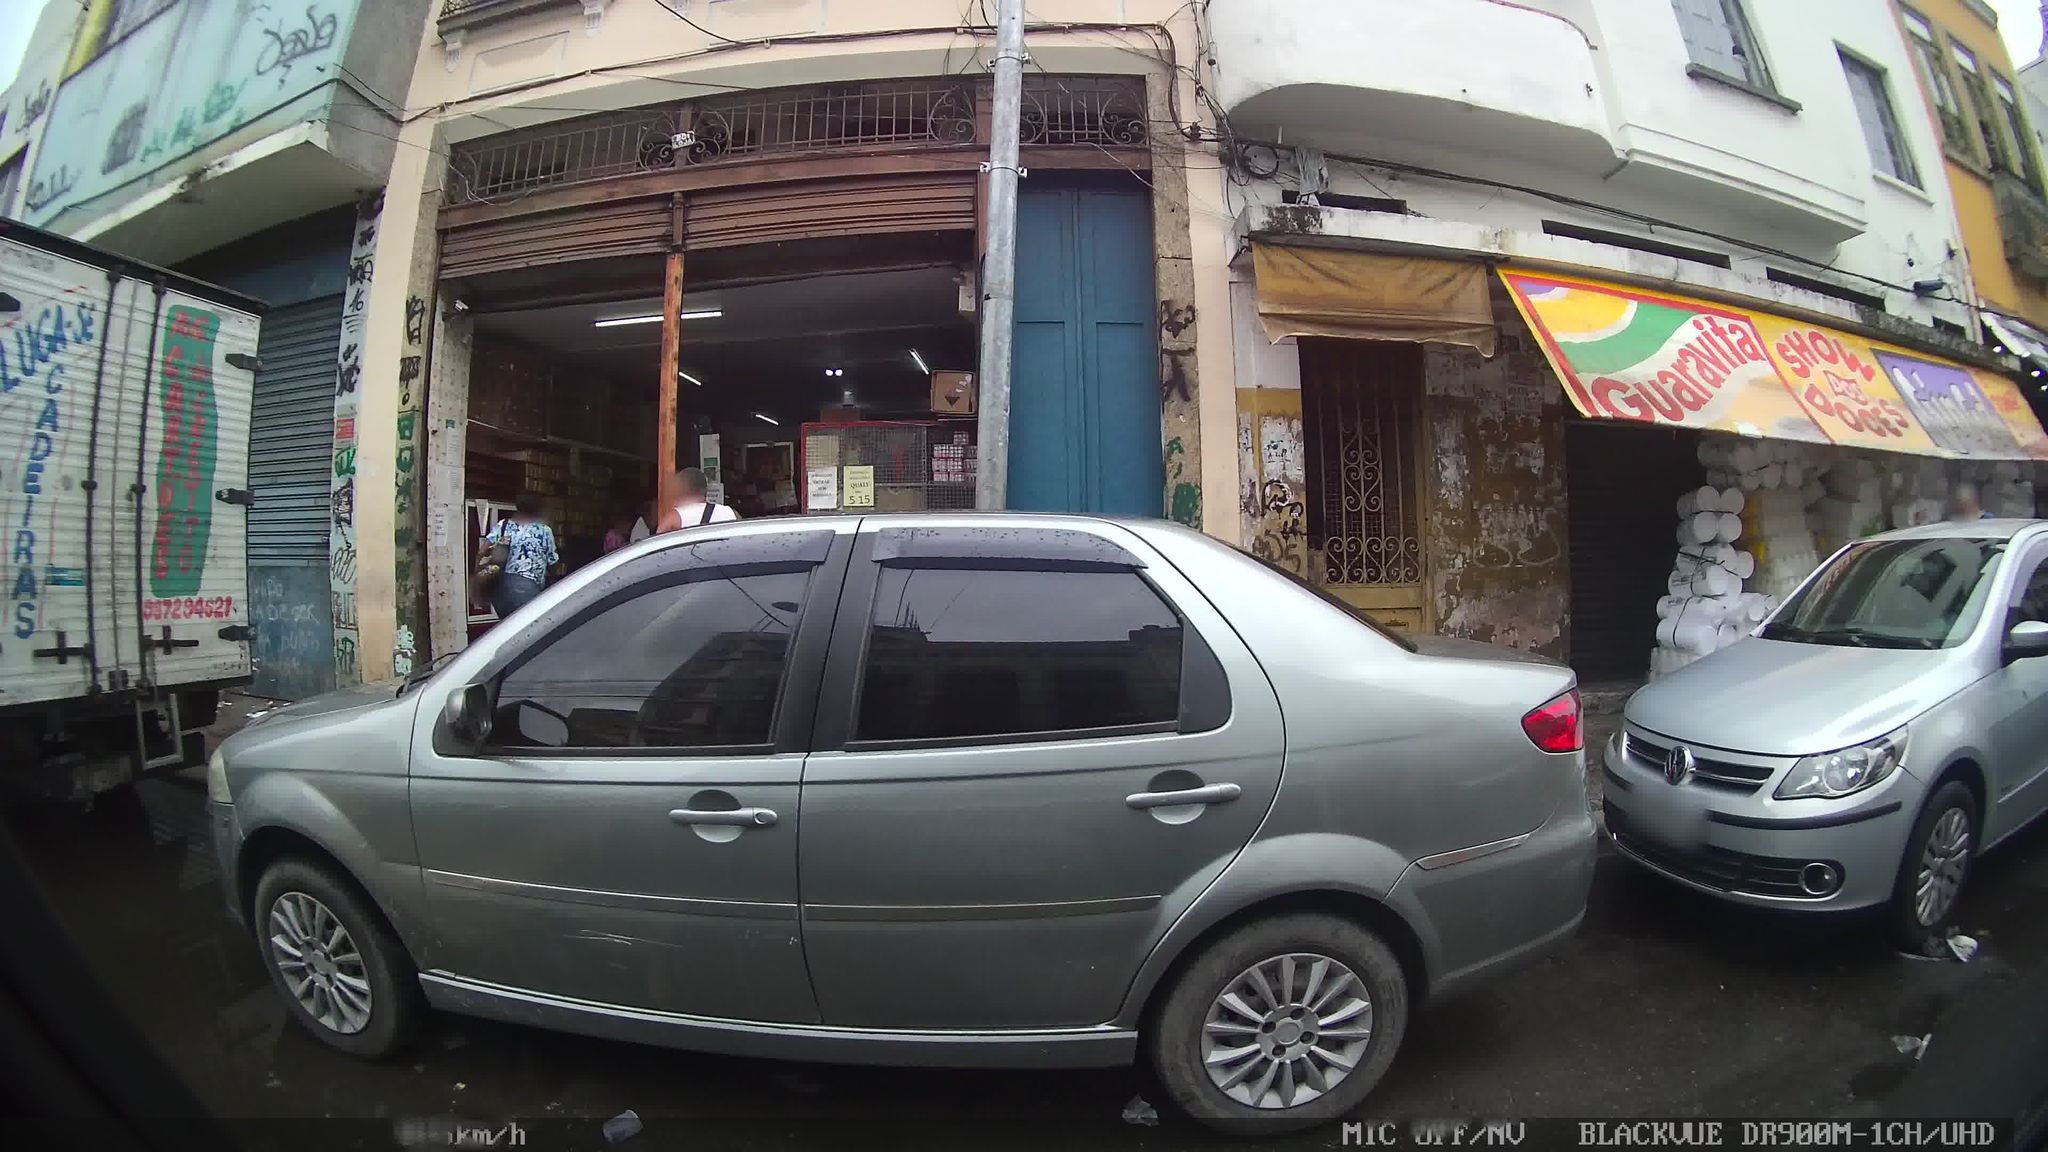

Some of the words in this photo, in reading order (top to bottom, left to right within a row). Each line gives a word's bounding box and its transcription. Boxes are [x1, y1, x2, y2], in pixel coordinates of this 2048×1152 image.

[1591, 316, 1766, 424] Guaravita
[1804, 383, 1909, 437] DOCES
[12, 363, 65, 640] CADEIRAS
